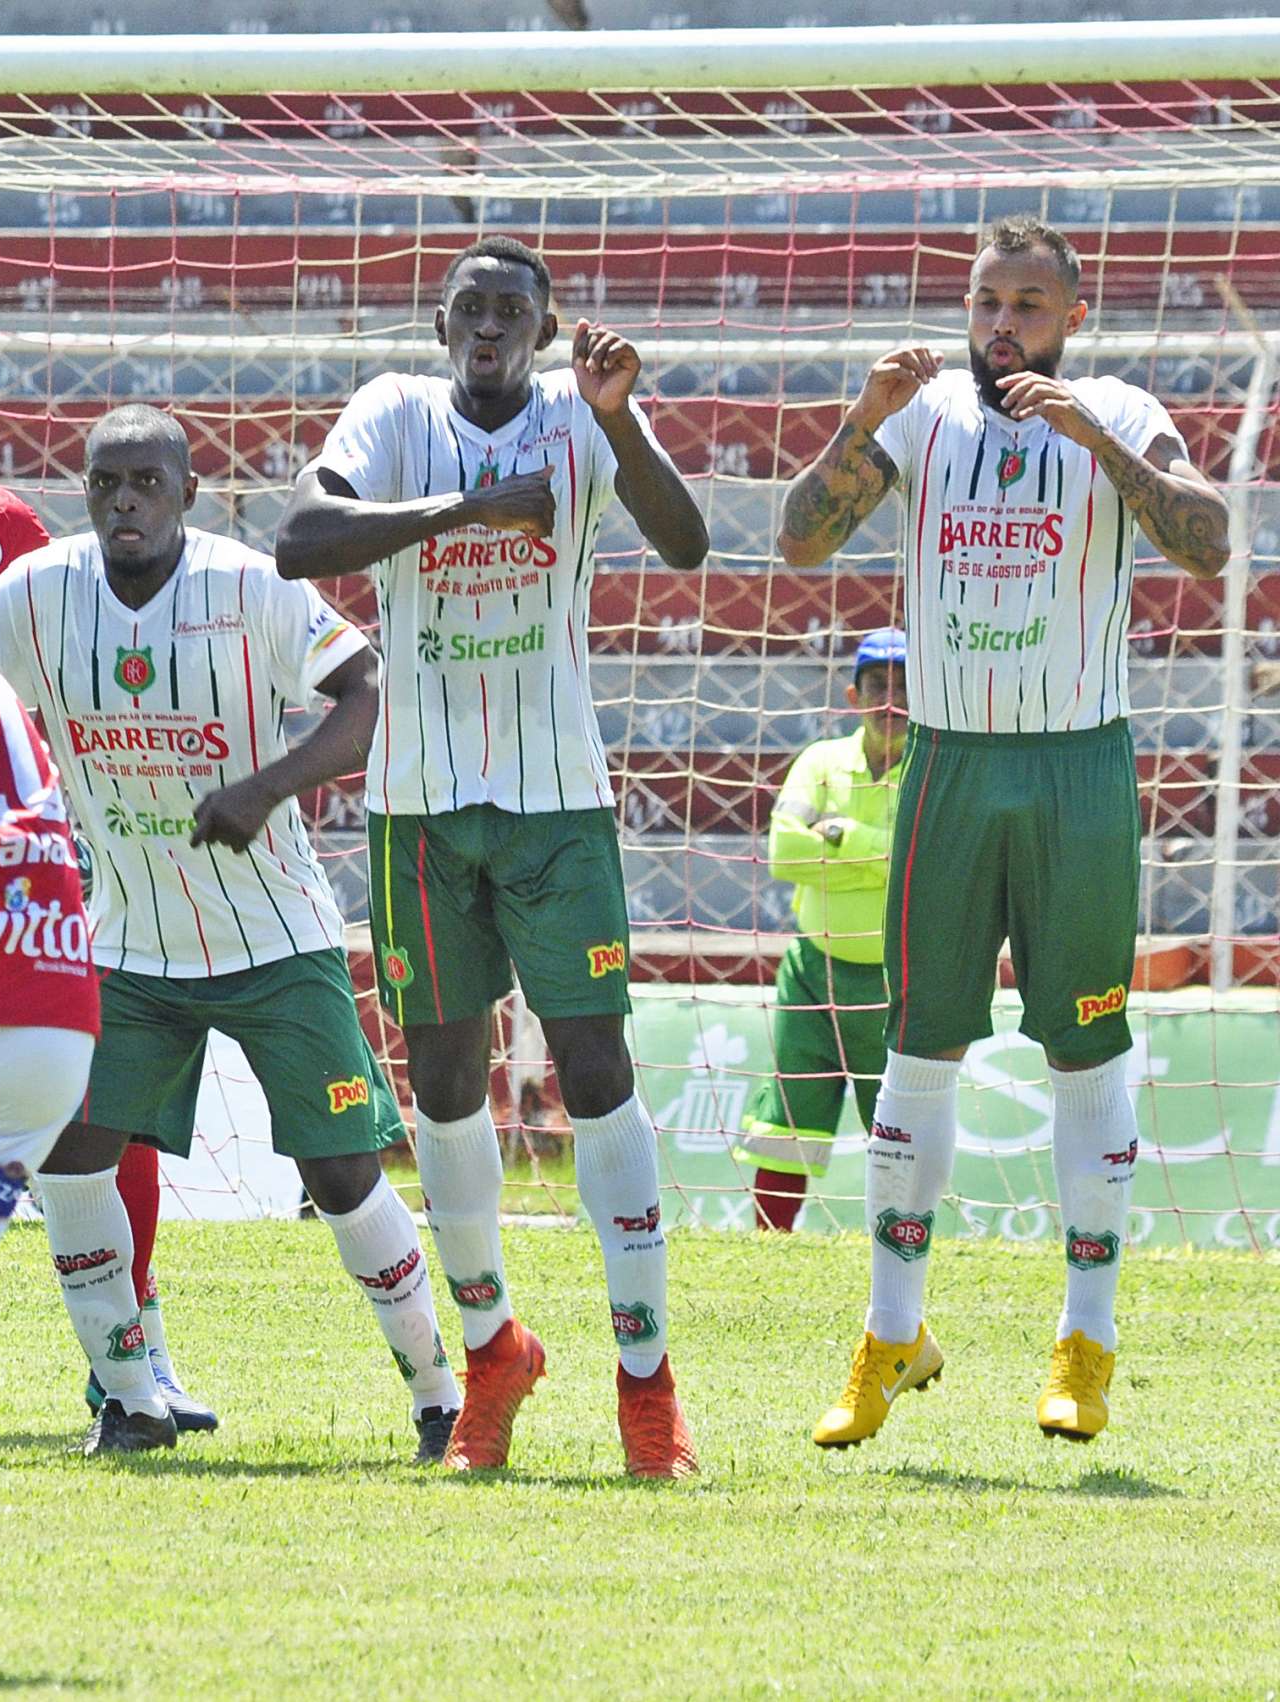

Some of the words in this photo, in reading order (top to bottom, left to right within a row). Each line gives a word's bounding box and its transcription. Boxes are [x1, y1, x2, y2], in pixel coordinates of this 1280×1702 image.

[419, 533, 558, 574] BARRETOS
[938, 512, 1064, 557] BARRETOS
[986, 564, 1022, 579] AGOSTO
[449, 623, 546, 662] Sicredi
[66, 719, 230, 761] BARRETOS
[1078, 987, 1124, 1022] Poty
[329, 1076, 368, 1111] Poty
